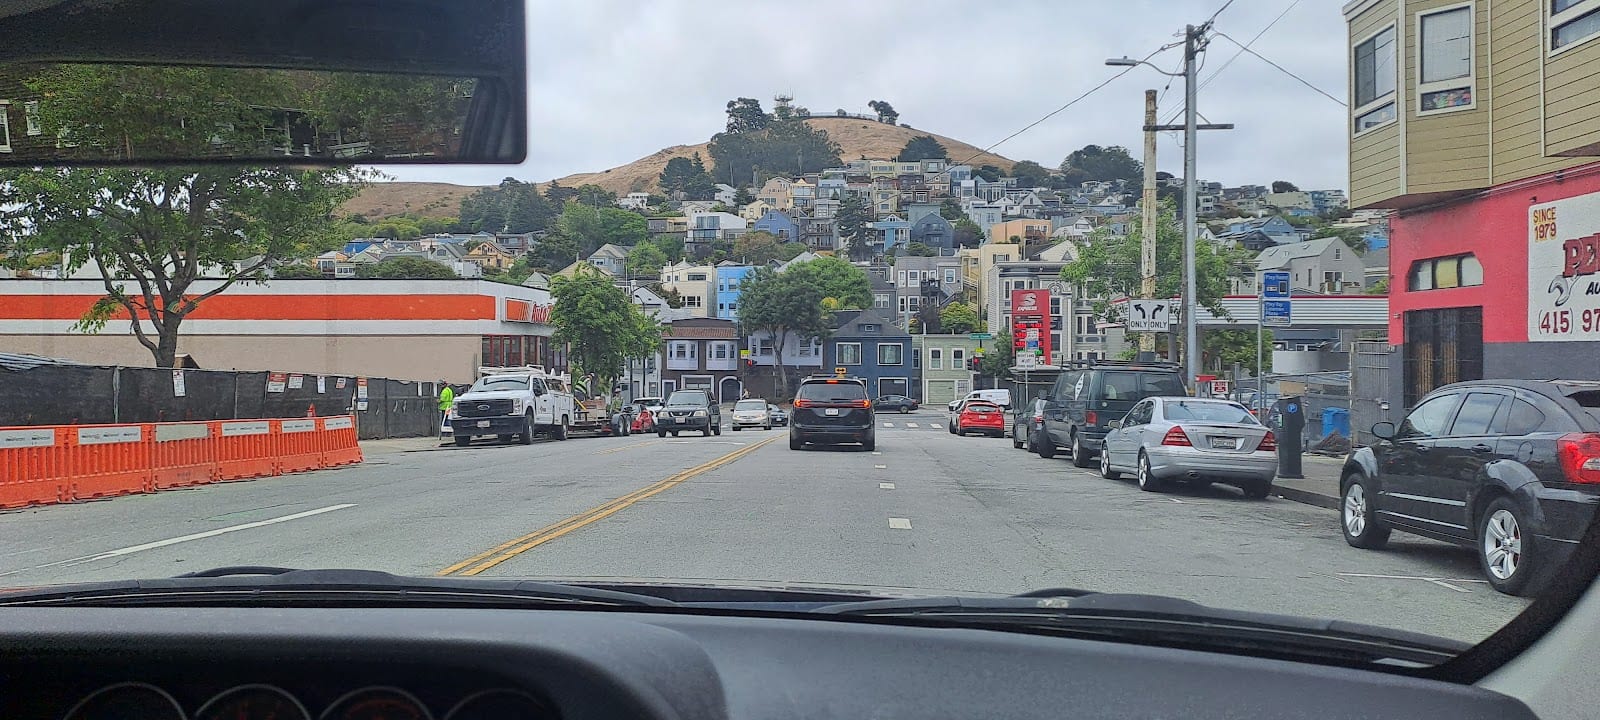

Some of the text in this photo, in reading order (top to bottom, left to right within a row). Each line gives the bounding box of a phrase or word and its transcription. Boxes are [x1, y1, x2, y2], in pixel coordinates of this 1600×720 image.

[1533, 207, 1557, 223] SINCE
[1534, 222, 1557, 241] 1979
[1562, 233, 1600, 278] PE
[1130, 320, 1148, 328] ONLY
[1538, 307, 1574, 335] (415)
